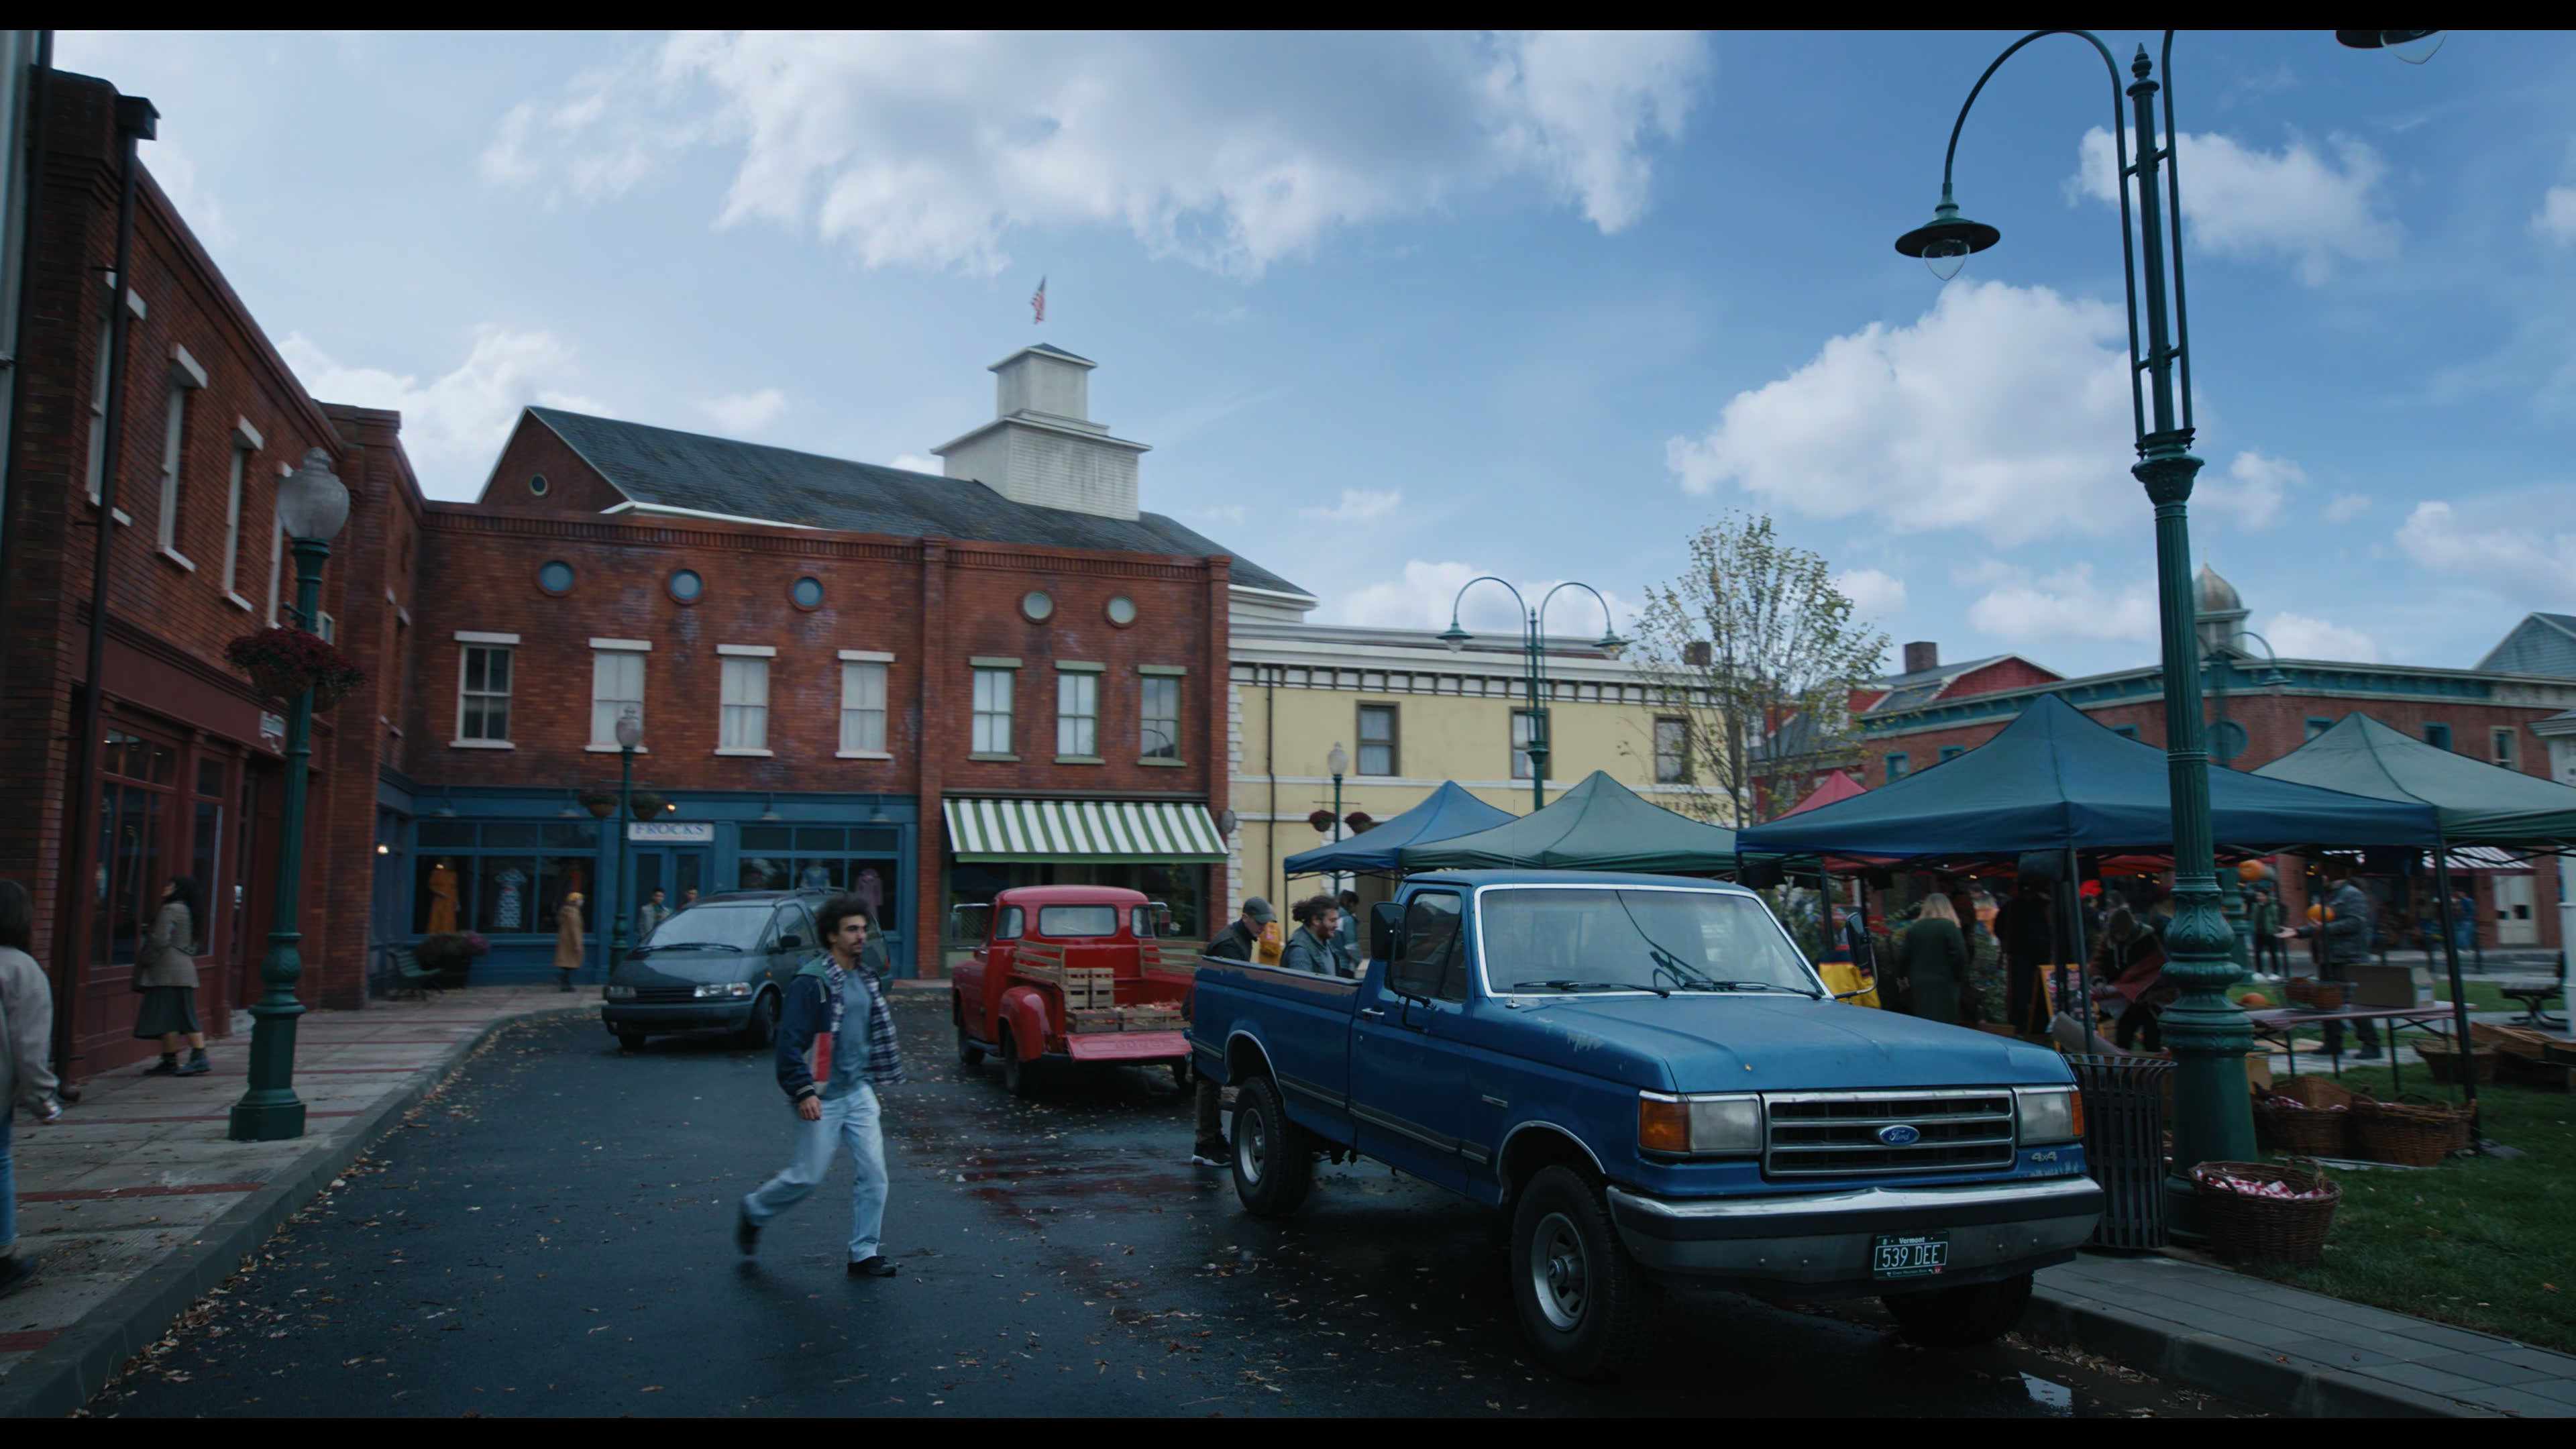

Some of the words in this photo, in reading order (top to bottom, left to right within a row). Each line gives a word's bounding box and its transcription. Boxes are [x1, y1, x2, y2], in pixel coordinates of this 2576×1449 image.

[636, 823, 704, 835] FROCKS
[1888, 1130, 1911, 1141] Ford
[1898, 1236, 1925, 1244] Vermont
[1882, 1246, 1909, 1267] 539
[1914, 1244, 1941, 1265] DEE
